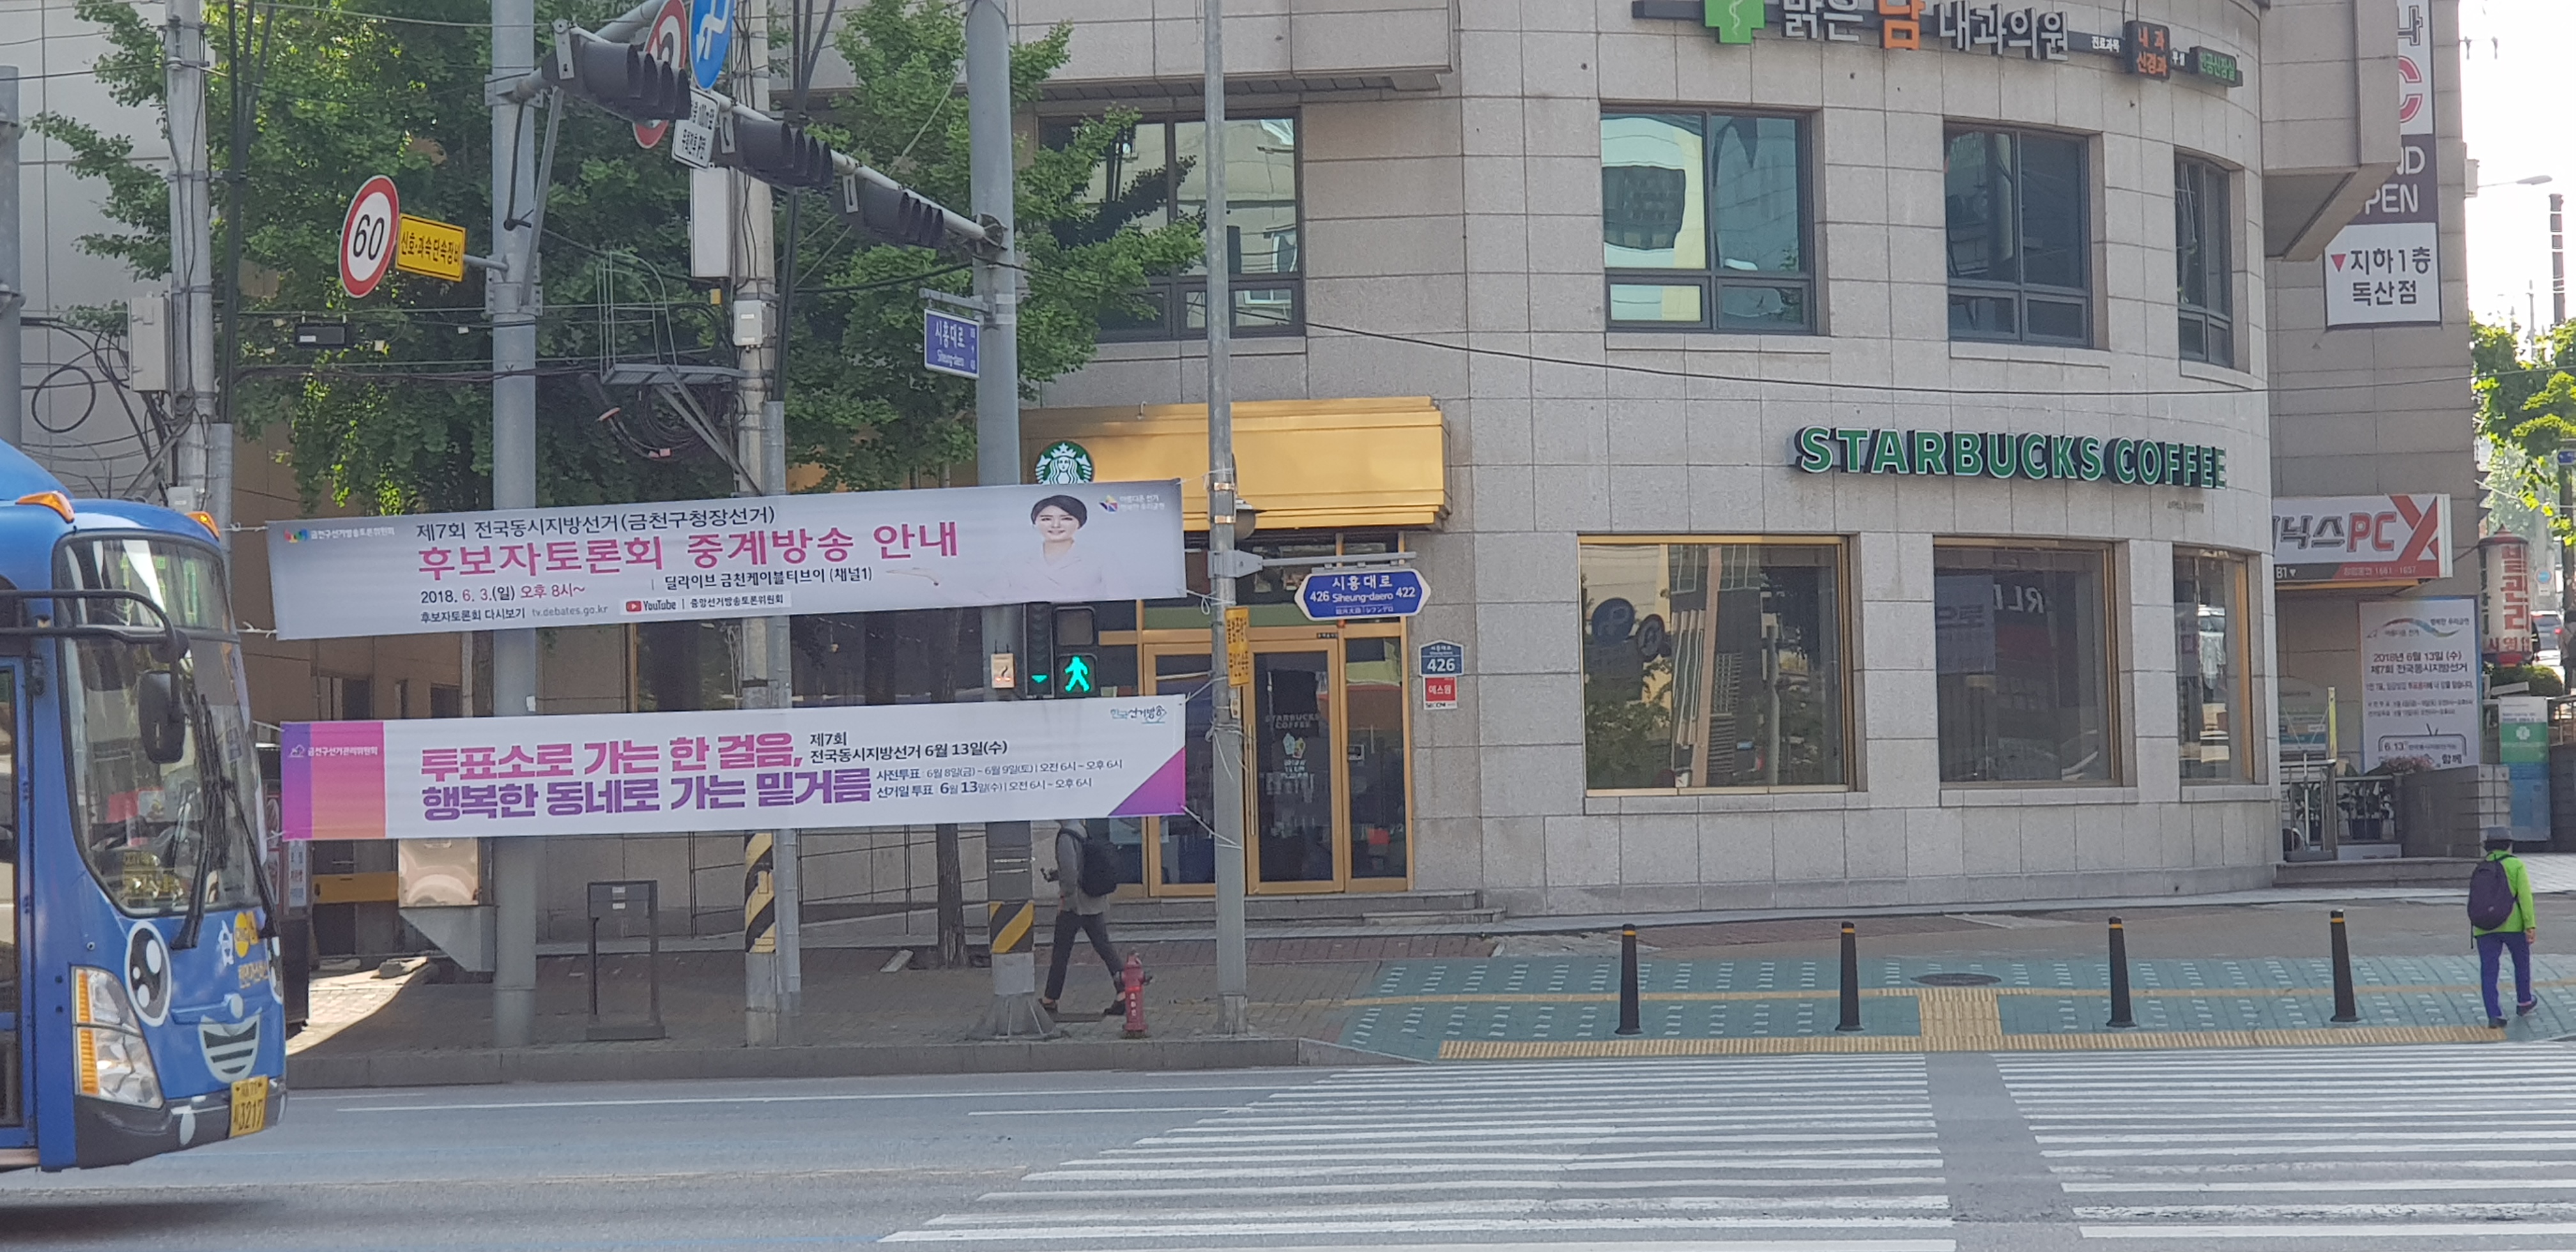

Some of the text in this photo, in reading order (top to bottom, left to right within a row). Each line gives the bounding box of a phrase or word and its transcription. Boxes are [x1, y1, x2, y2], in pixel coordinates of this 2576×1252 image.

[1938, 1, 2069, 61] 내과의원
[2136, 52, 2168, 76] 신경과
[353, 214, 385, 261] 60
[2350, 247, 2431, 275] 지하1층
[2352, 280, 2418, 306] 독산점
[935, 320, 965, 349] 시흥대로
[1797, 425, 2228, 489] STARBUCKS COFFEE
[417, 505, 776, 542] 제7회 전국동시지방선거(금천구청장선거)
[418, 521, 958, 581] 후보자토론회 중계방송 안내
[665, 567, 873, 591] 딜라이브 금천케이블티브이 (채널1)
[1332, 574, 1393, 591] 시흥대로
[2276, 566, 2287, 579] B1
[420, 591, 458, 604] 2018.
[521, 584, 547, 599] 오후
[643, 599, 677, 611] YouTube
[1310, 586, 1416, 604] 426 Siheung-daero 422
[420, 604, 608, 624] 후보자토론회 다시보기 tv.debates.go.kr
[1427, 658, 1455, 672] 426
[2425, 651, 2444, 661] 13일
[2446, 650, 2462, 661] (수)
[2371, 664, 2394, 675] 제7회
[810, 732, 847, 747] 제7회
[421, 731, 803, 782] 투표소로 가는 한 걸음,
[809, 740, 1008, 764] 전국동시지방선거 6월 13일(수)
[877, 759, 1123, 781] 사전투표 6월 8일(금) 6월 9일(토) 오전 6시 오후 6시
[422, 768, 871, 821] 행복한 동네로 가는 밑거름
[877, 777, 1092, 798] 선거일 투표 6월 13일(수) 오전 6시 오후 6시
